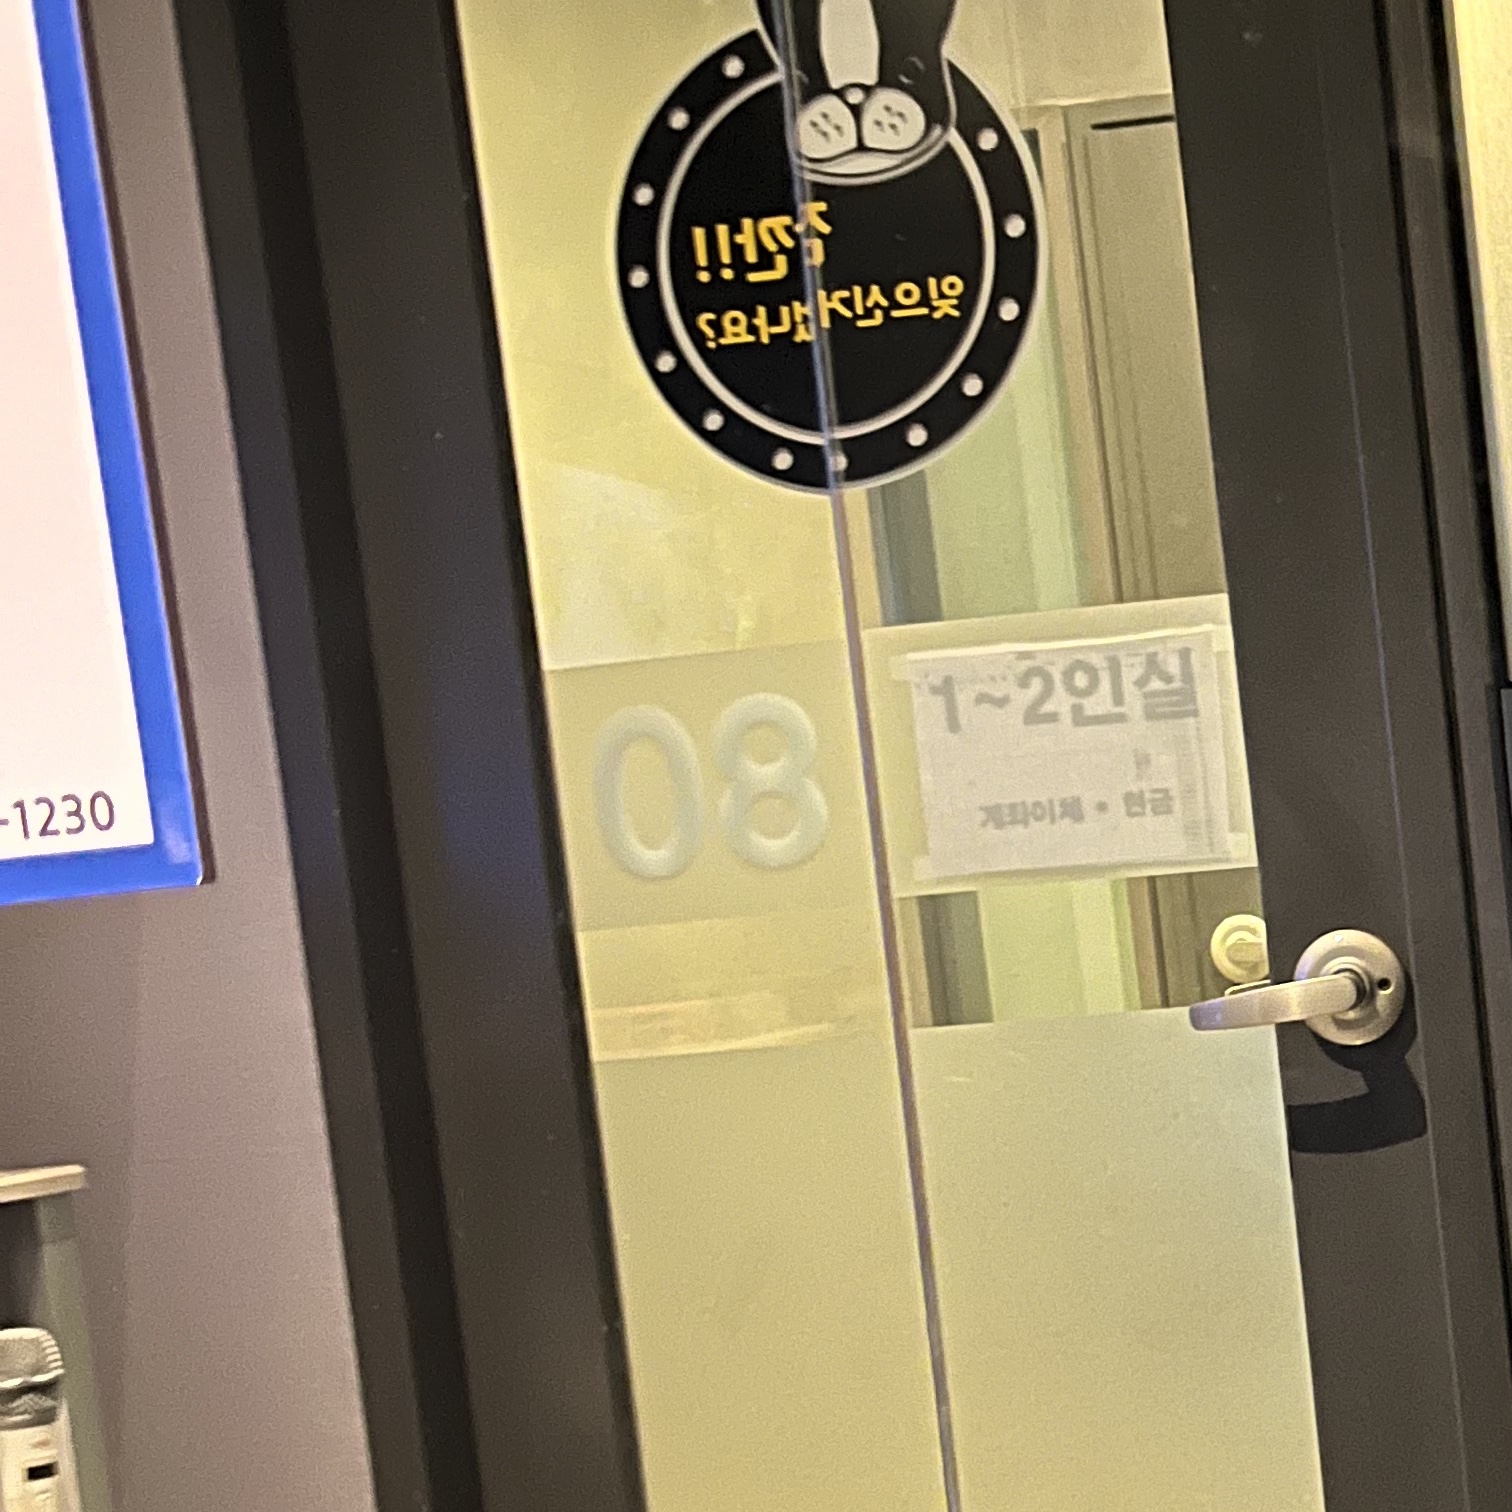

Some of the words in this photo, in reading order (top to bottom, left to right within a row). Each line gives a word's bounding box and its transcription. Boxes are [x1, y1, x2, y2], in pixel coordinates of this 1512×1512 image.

[928, 646, 1199, 734] 1~2인실
[593, 693, 828, 880] 08
[1122, 788, 1176, 818] 현금
